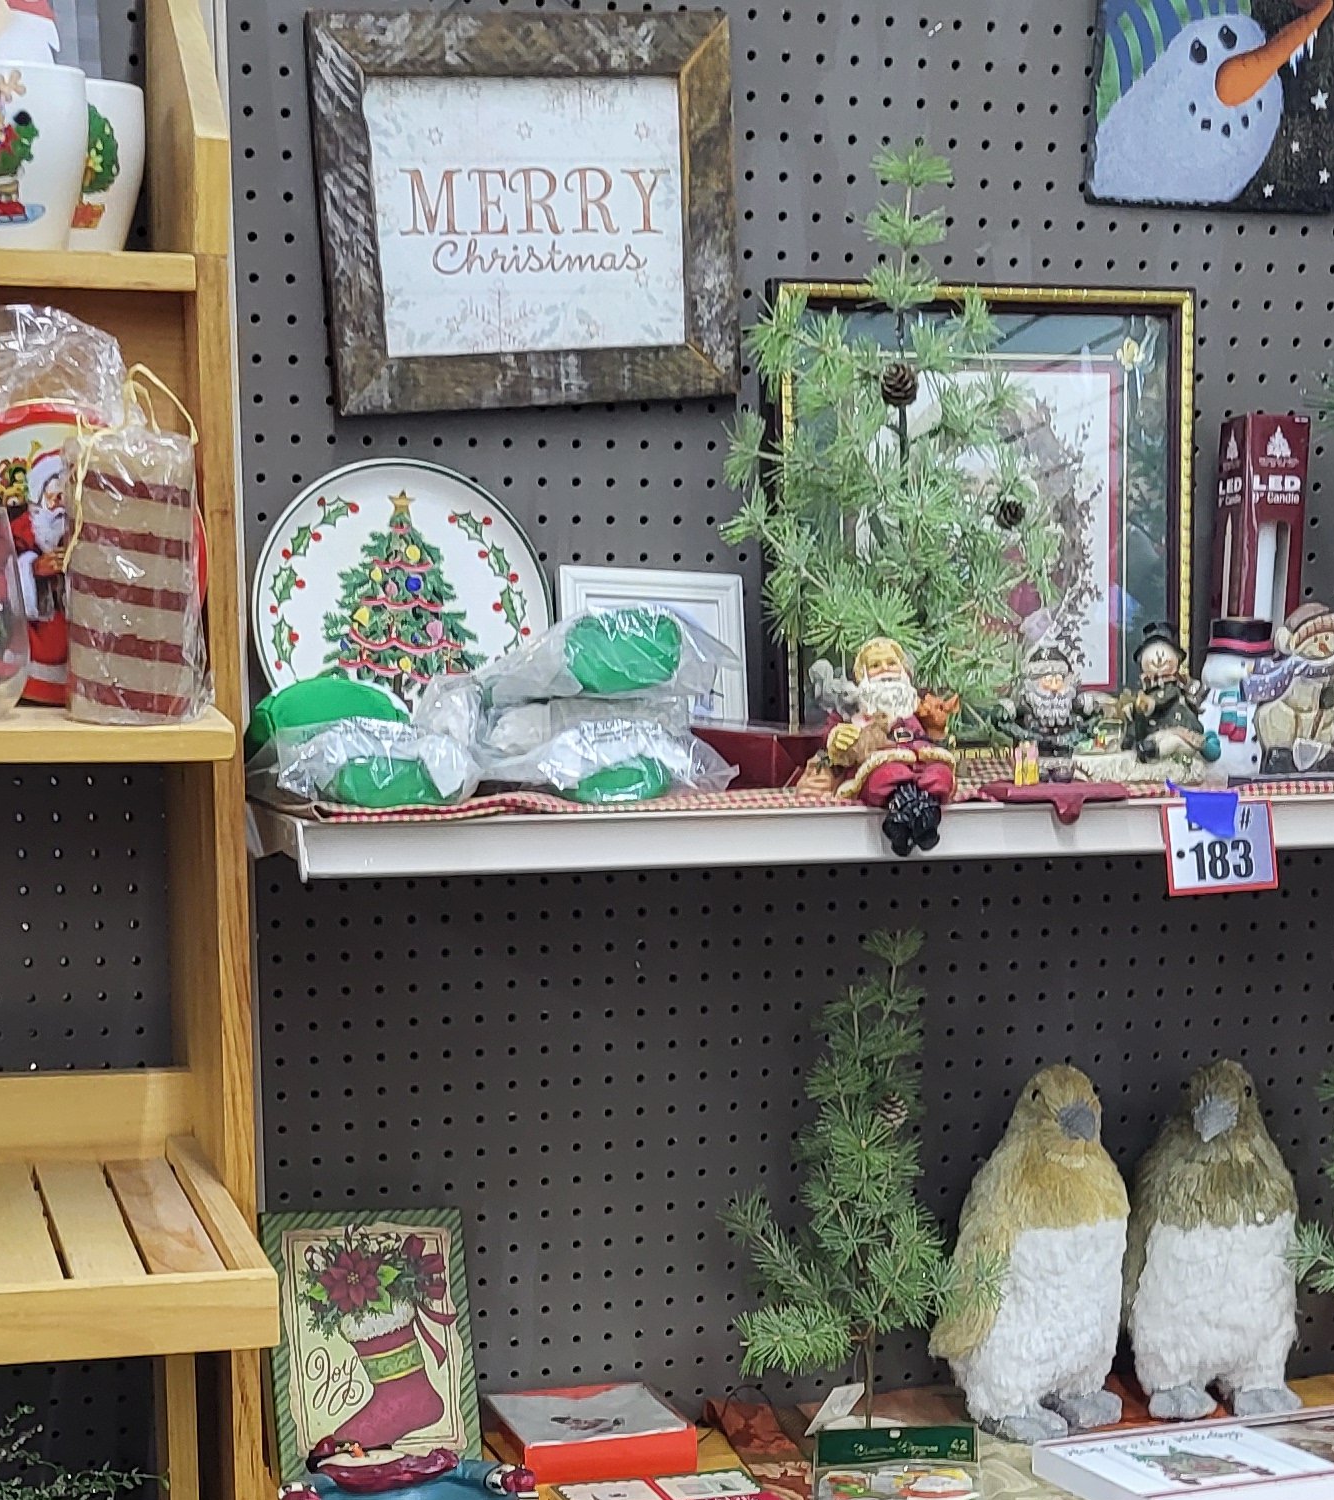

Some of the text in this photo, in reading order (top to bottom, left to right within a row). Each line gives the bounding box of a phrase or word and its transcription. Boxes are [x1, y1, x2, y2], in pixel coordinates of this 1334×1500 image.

[399, 166, 671, 235] MERRY
[432, 237, 648, 276] Christmas
[1218, 476, 1243, 496] LED
[1252, 474, 1301, 492] LED
[1267, 491, 1300, 505] Candle
[1188, 839, 1255, 882] 183
[305, 1346, 365, 1417] Joy
